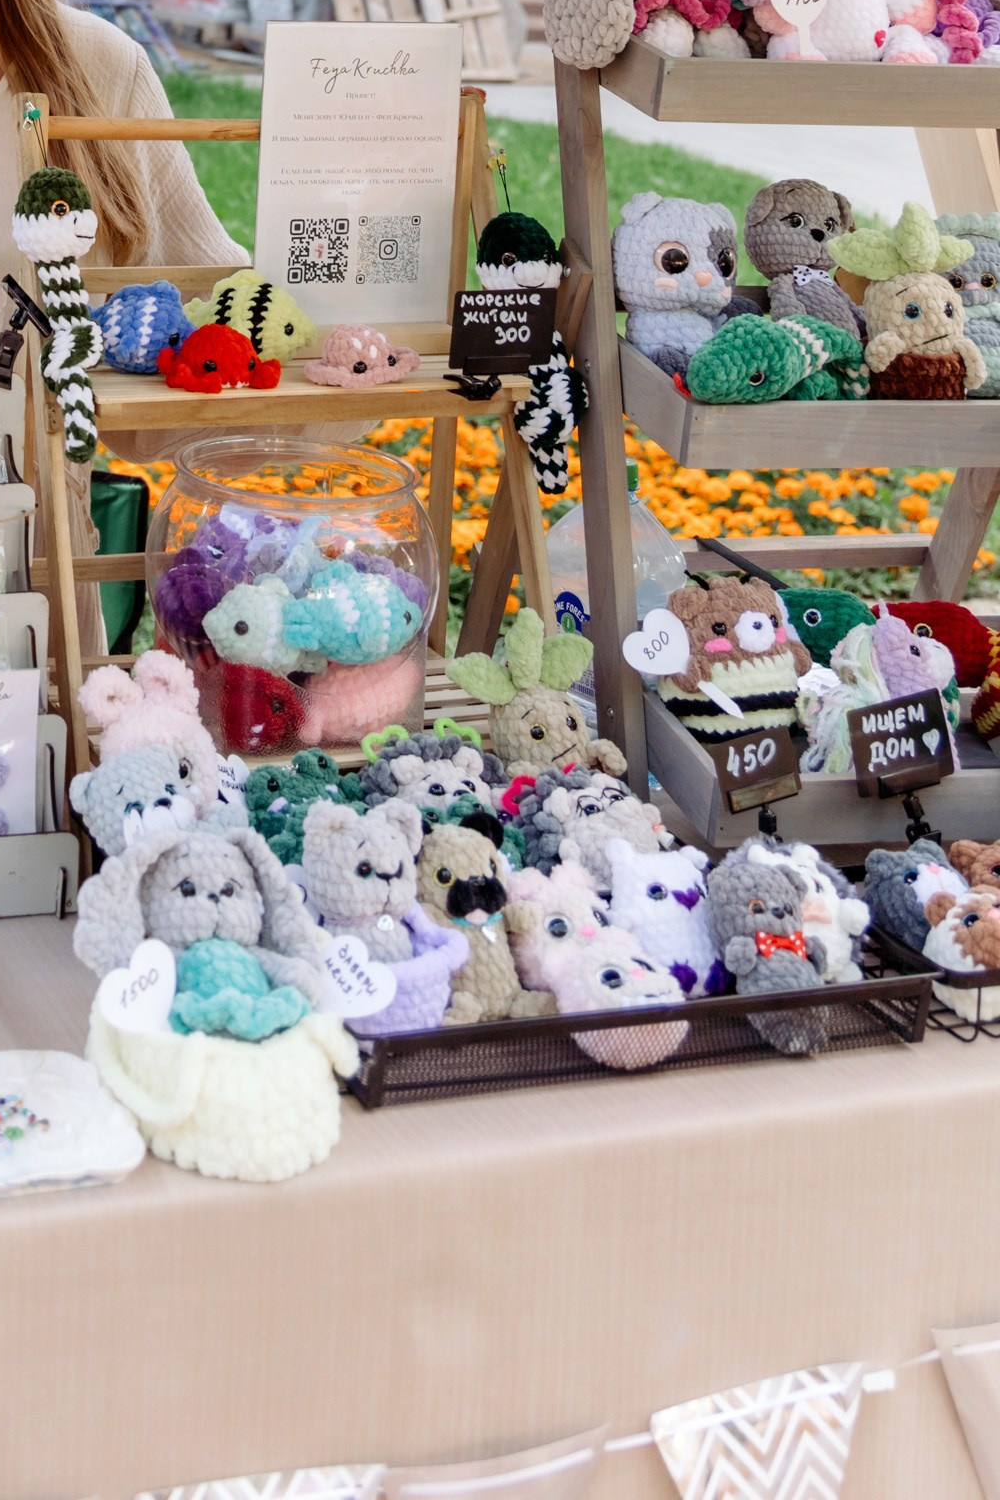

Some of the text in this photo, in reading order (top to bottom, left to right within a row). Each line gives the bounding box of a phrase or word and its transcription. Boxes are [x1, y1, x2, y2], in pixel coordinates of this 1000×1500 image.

[345, 91, 376, 100] Привет!
[293, 113, 314, 121] Меня
[495, 325, 531, 345] 300
[565, 601, 588, 622] FORES
[643, 630, 670, 661] 800
[862, 703, 925, 734] ИЩЕМ
[727, 738, 776, 777] 450
[868, 737, 915, 772] ДОМ
[119, 967, 160, 1009] 1500
